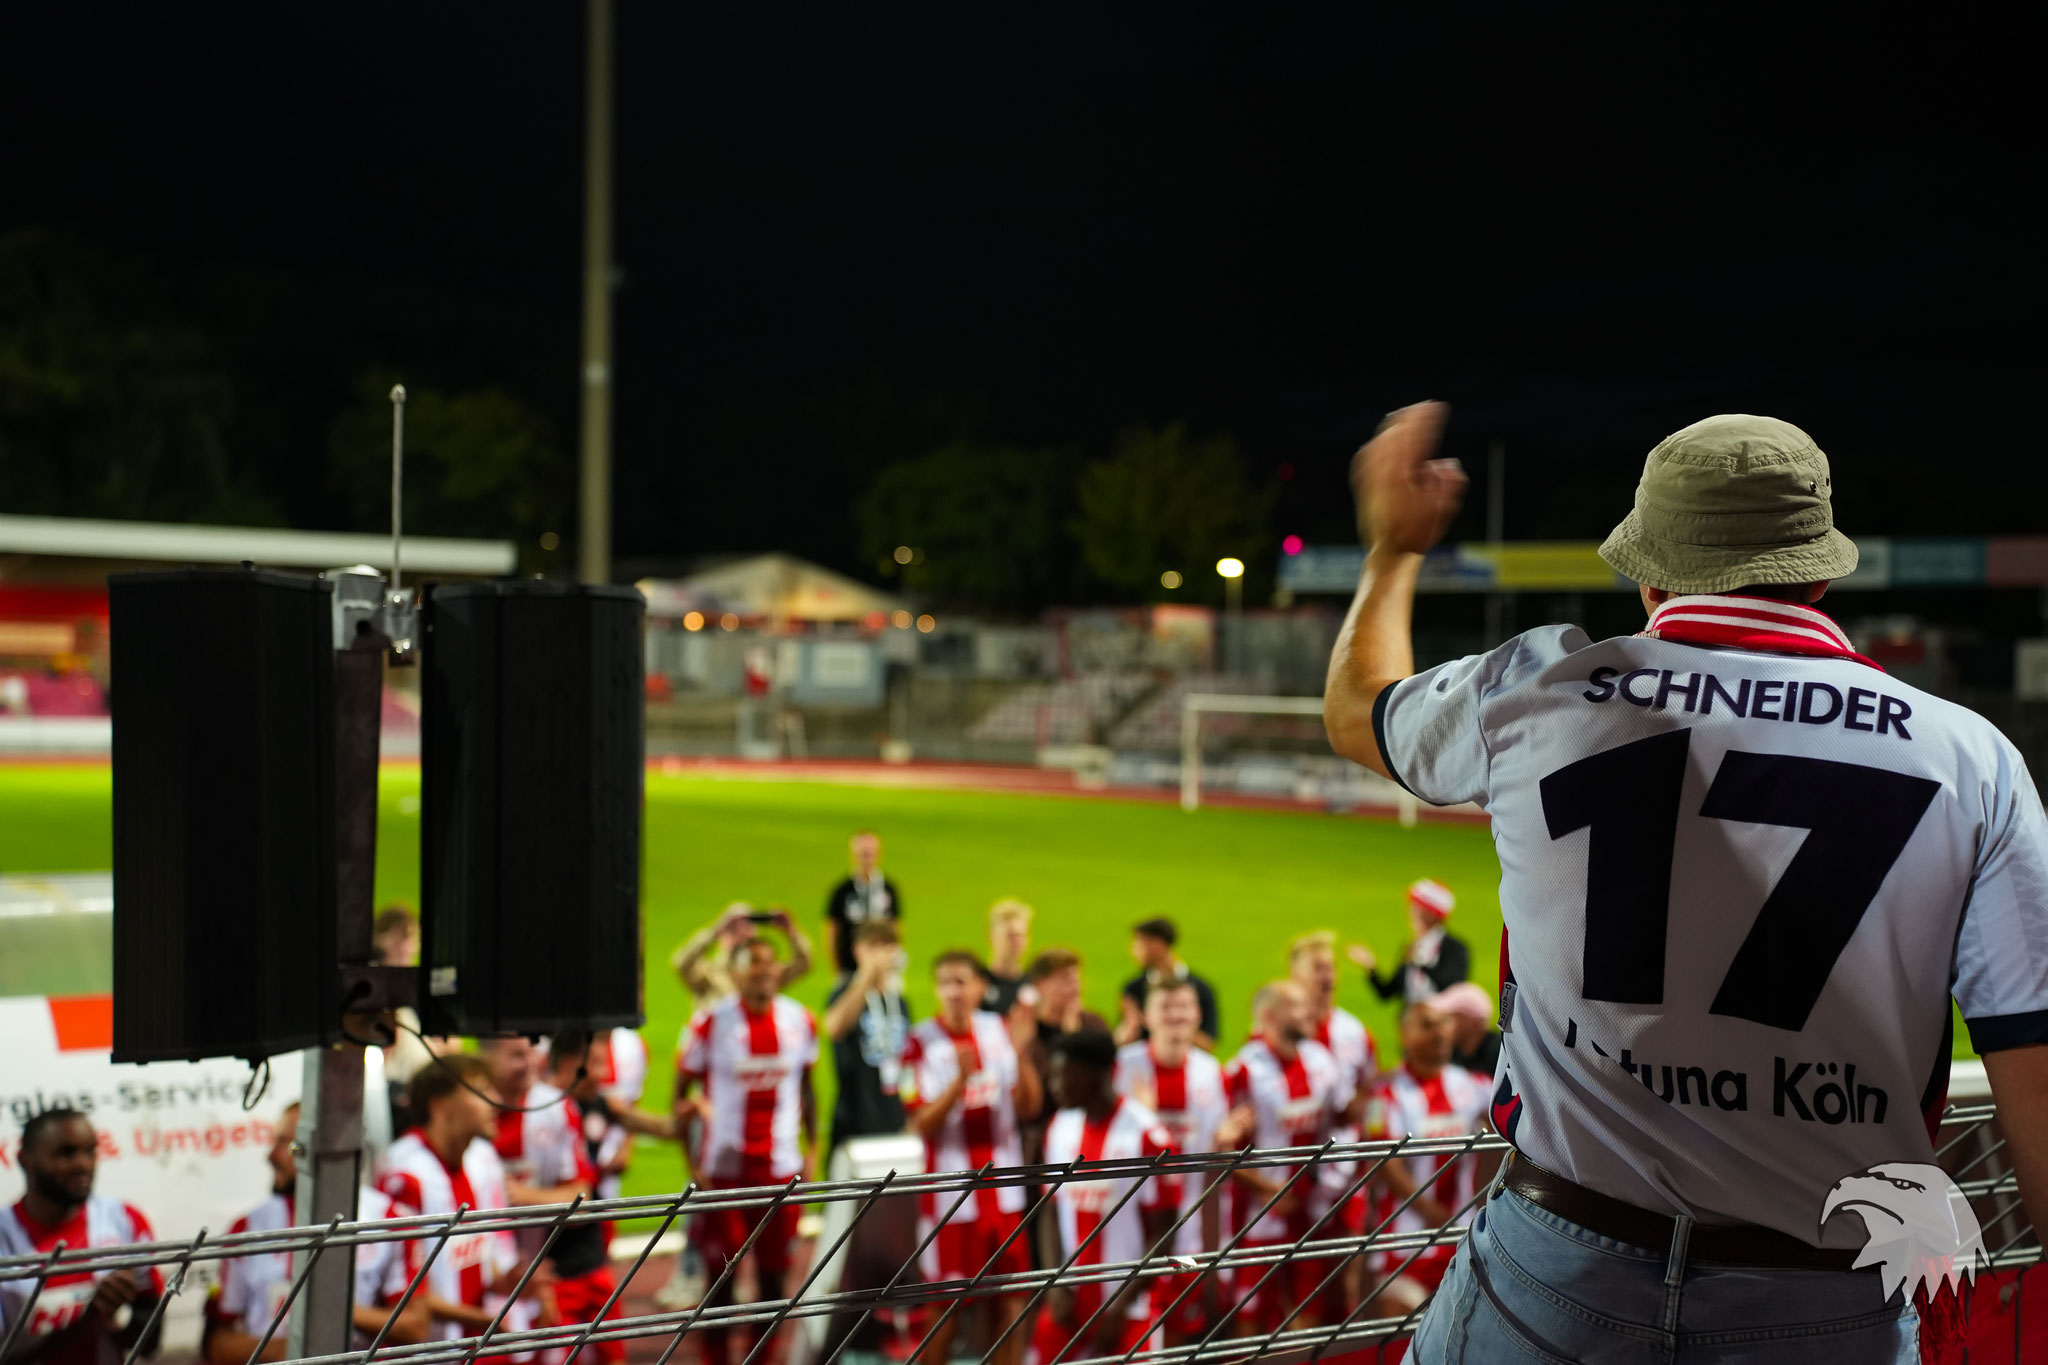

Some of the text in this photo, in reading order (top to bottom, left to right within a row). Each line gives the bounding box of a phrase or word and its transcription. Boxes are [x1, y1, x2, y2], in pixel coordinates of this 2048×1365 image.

[1583, 666, 1912, 741] SCHNEIDER
[1539, 727, 1942, 1032] 17
[1773, 1056, 1889, 1125] Köln
